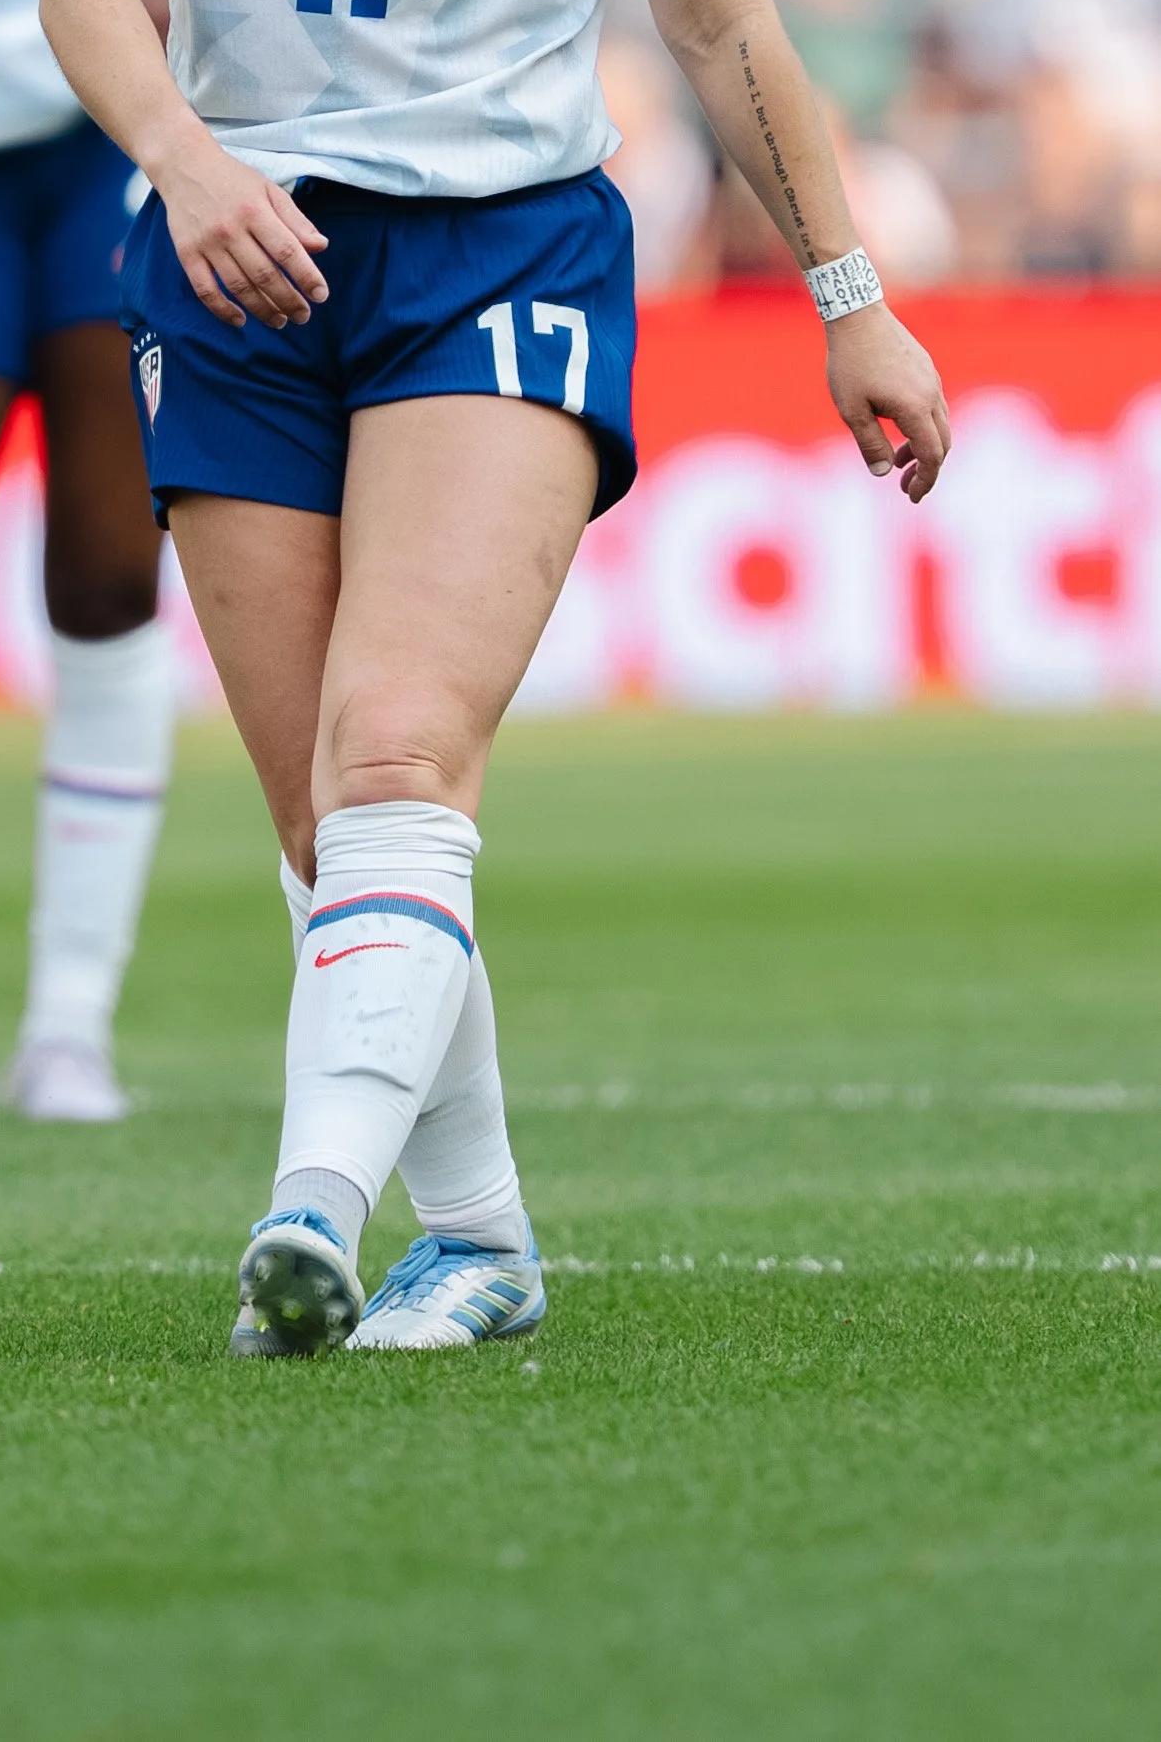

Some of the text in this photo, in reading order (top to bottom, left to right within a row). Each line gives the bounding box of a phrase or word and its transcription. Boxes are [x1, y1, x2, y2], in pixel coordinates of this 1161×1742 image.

[739, 41, 749, 62] Yet
[744, 66, 755, 89] not
[756, 106, 768, 128] but
[765, 131, 788, 184] through
[784, 187, 805, 229] Christ
[800, 233, 810, 247] in
[477, 301, 589, 416] 17
